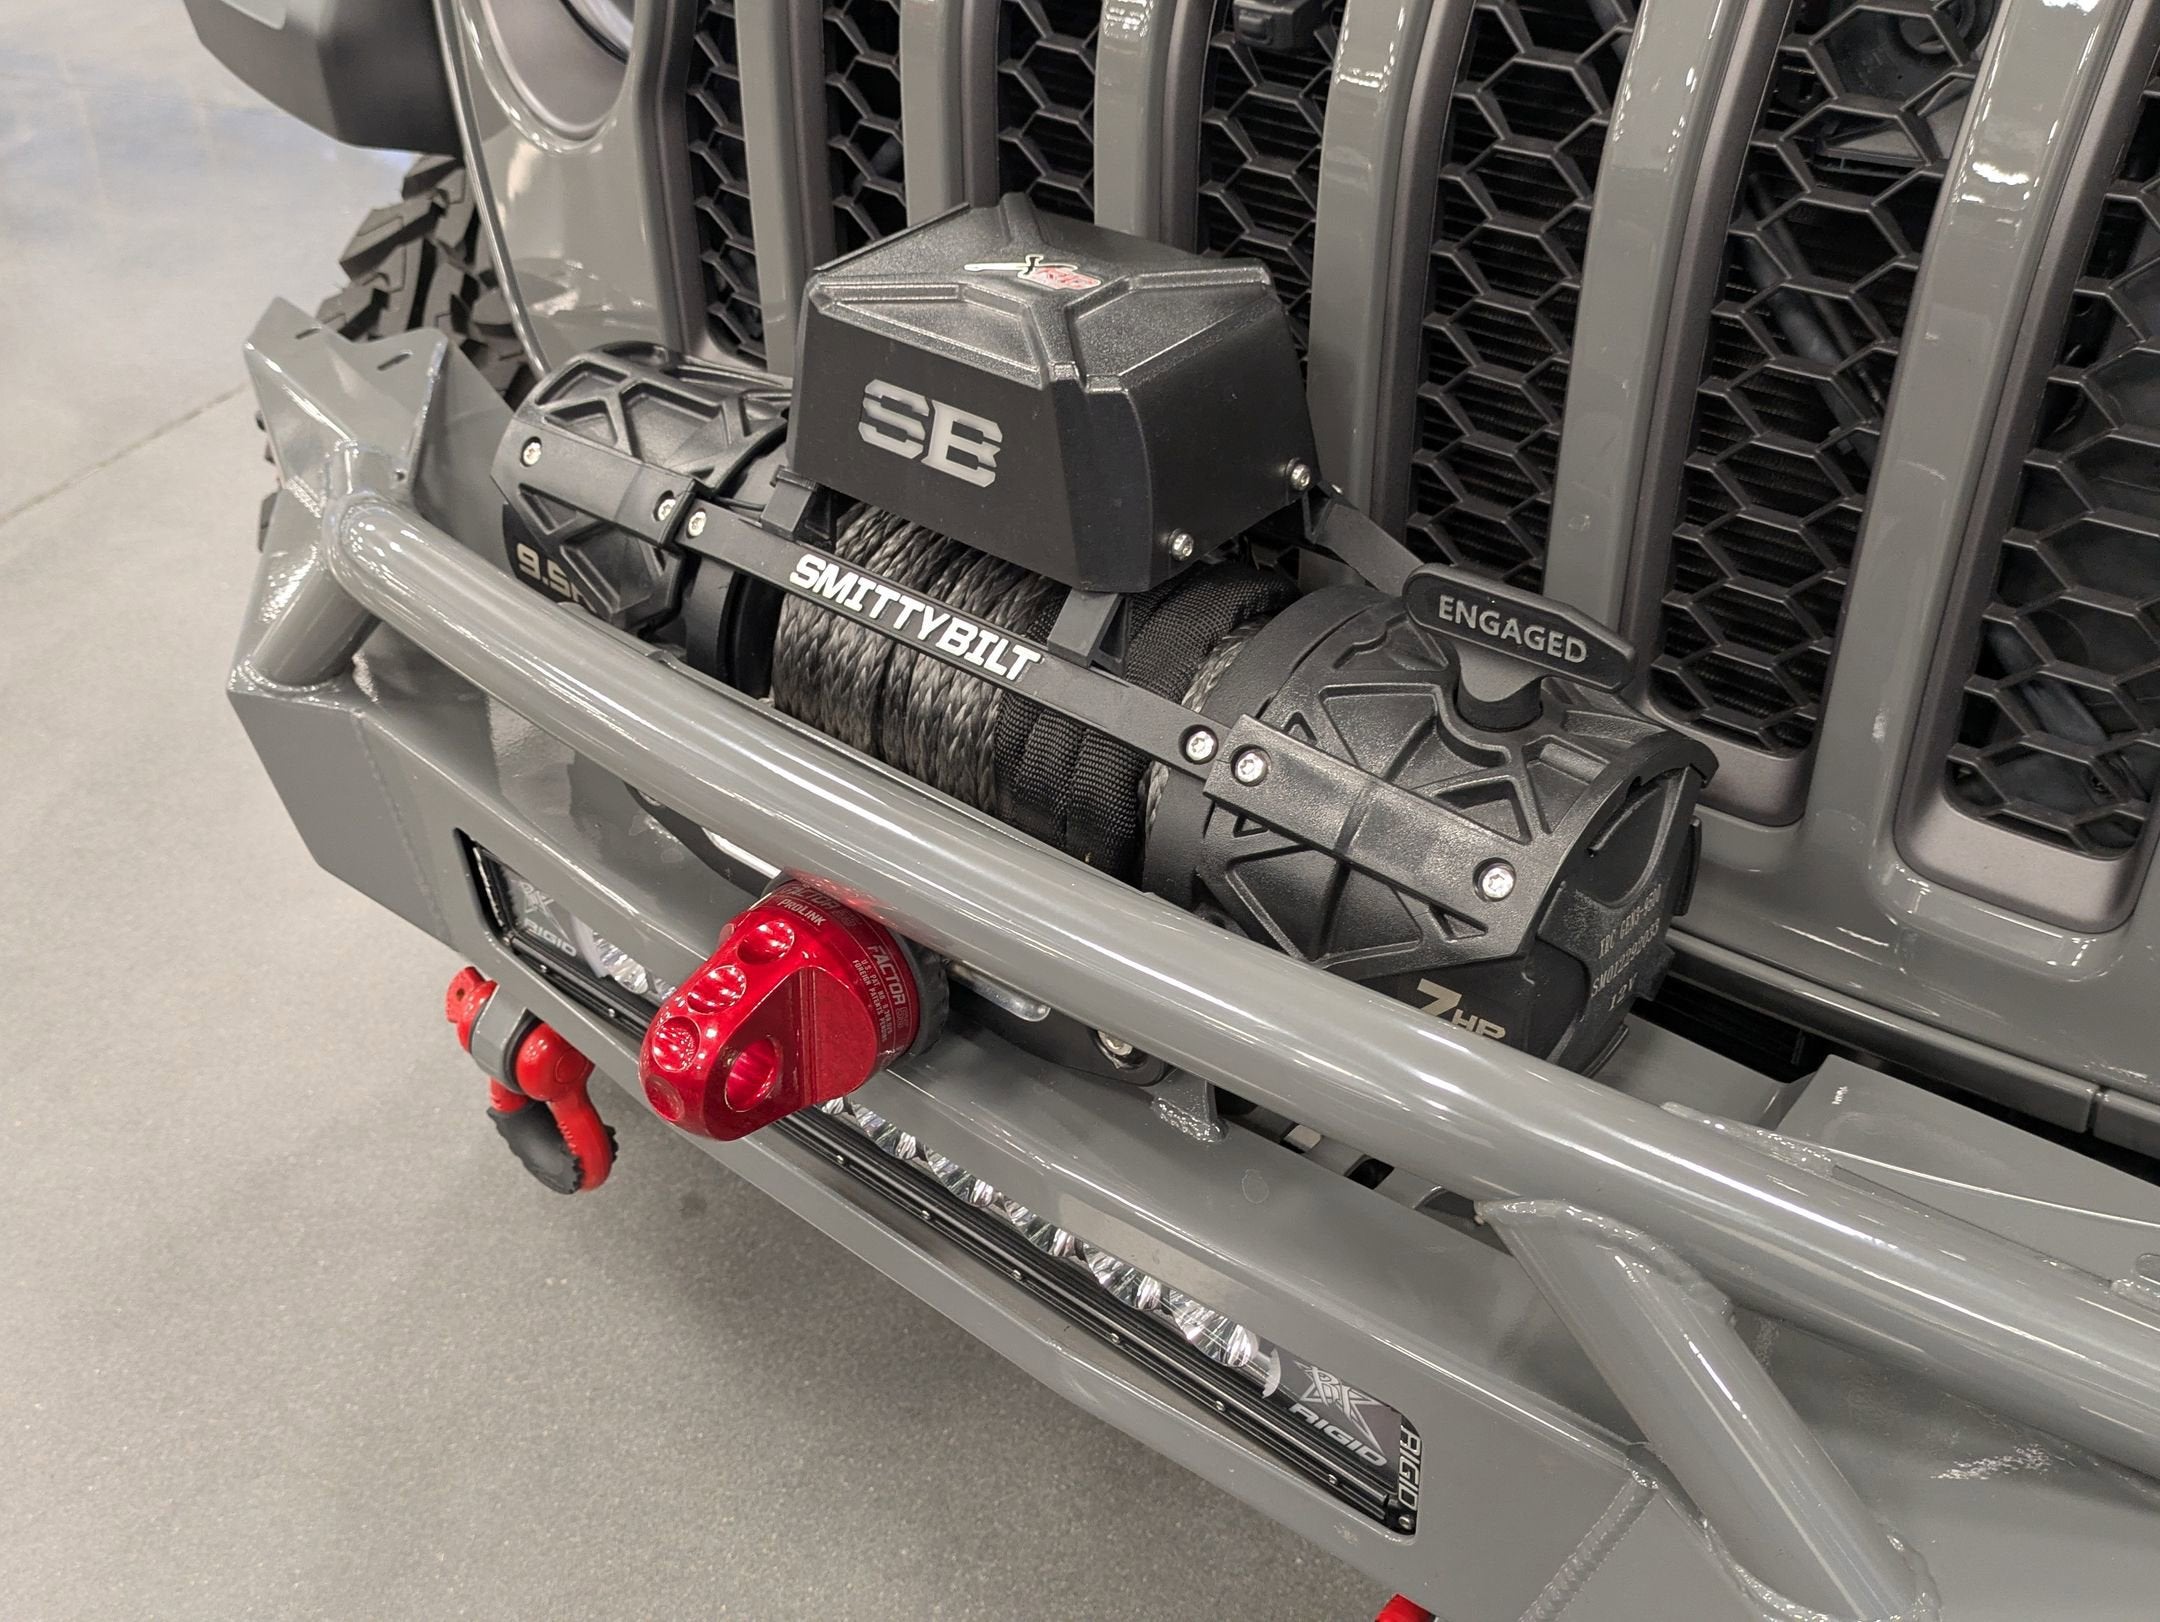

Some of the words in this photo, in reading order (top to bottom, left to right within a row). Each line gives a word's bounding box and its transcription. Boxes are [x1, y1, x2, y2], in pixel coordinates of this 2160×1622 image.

[858, 378, 1003, 488] SB
[789, 553, 1042, 681] SMITTYBILT
[1438, 594, 1588, 664] ENGAGED
[523, 917, 577, 957] RIGID
[852, 959, 872, 986] FOREIGN
[868, 987, 885, 1016] PATENTS
[867, 944, 906, 1006] FACTOR
[1289, 1402, 1388, 1467] RIGID
[1399, 1424, 1421, 1511] RIGID
